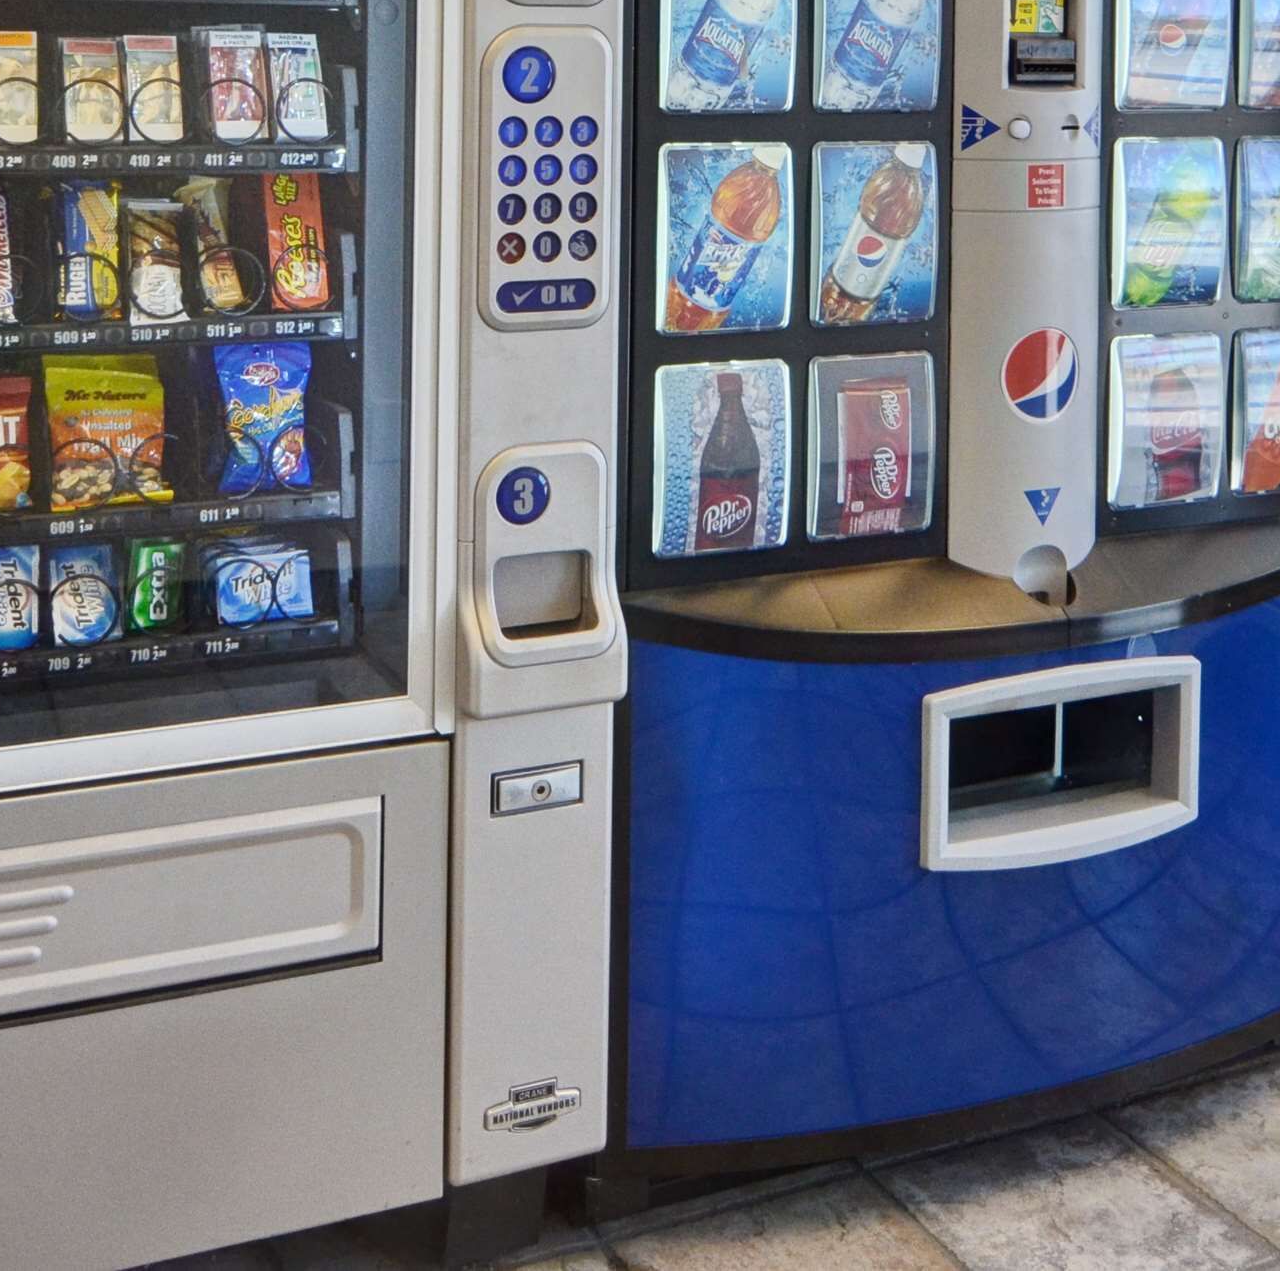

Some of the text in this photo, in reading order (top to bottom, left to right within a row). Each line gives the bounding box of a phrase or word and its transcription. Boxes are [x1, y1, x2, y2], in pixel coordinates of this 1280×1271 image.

[699, 18, 745, 64] AQUAFINA
[847, 19, 894, 65] AQUAFINA
[520, 57, 540, 93] 2
[506, 121, 589, 142] 1 2 3
[52, 155, 75, 167] 409
[130, 154, 149, 167] 410
[204, 153, 223, 166] 411
[281, 154, 299, 165] 412
[504, 160, 588, 180] 4 5 6
[505, 197, 588, 219] 7 8 9
[276, 213, 307, 299] Reese's
[541, 284, 577, 305] OK
[131, 328, 152, 341] 510
[207, 324, 224, 337] 511
[276, 322, 294, 334] 512
[54, 331, 78, 344] 509
[93, 391, 147, 401] Nature
[513, 478, 534, 515] 3
[200, 508, 219, 522] 611
[720, 500, 739, 516] Dr
[51, 519, 74, 534] 609
[702, 506, 750, 534] Pepper
[150, 552, 167, 621] Extra
[232, 563, 294, 593] Trident
[0, 560, 27, 629] Trident
[62, 563, 92, 628] Trident
[131, 649, 149, 663] 710
[206, 641, 223, 653] 711
[48, 657, 70, 671] 709
[493, 1097, 576, 1124] NATIONAL VENDORS
